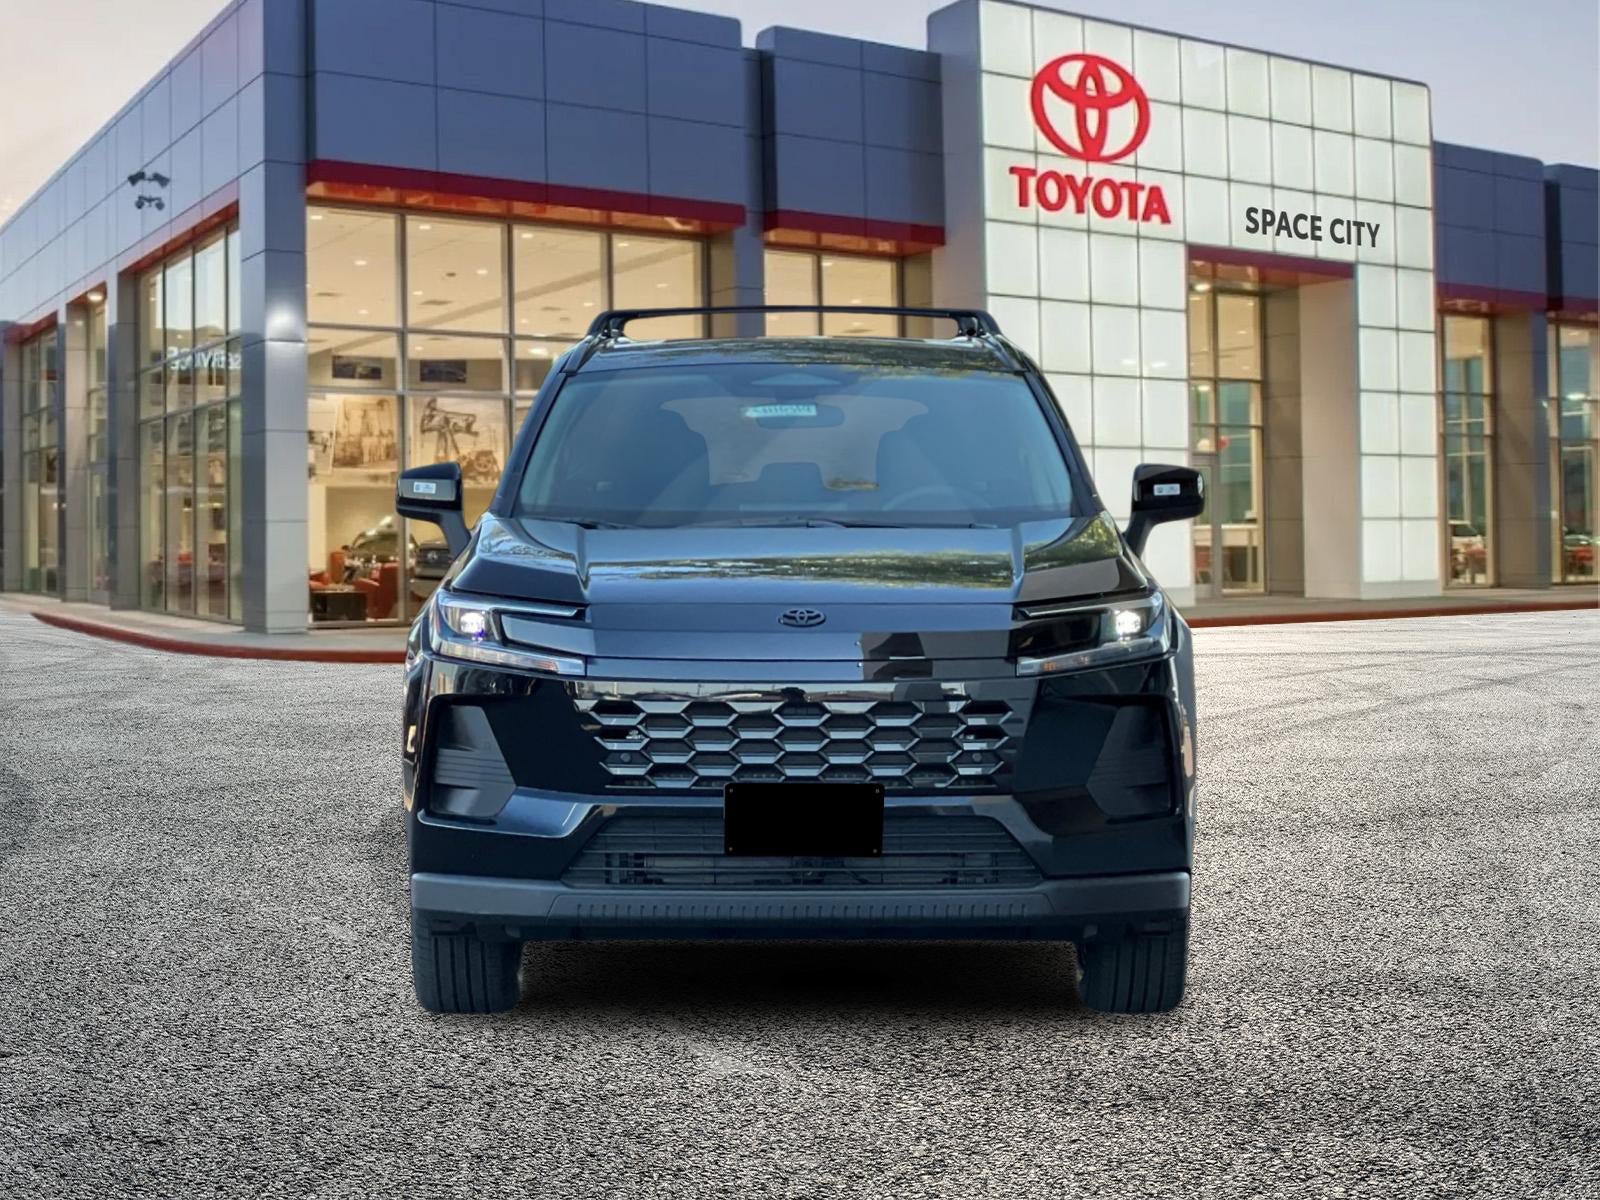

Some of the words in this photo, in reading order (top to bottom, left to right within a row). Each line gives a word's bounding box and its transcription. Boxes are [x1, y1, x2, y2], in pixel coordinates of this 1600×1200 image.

[1008, 166, 1171, 224] TOYOTA
[1245, 206, 1323, 242] SPACE
[1329, 217, 1381, 248] CITY
